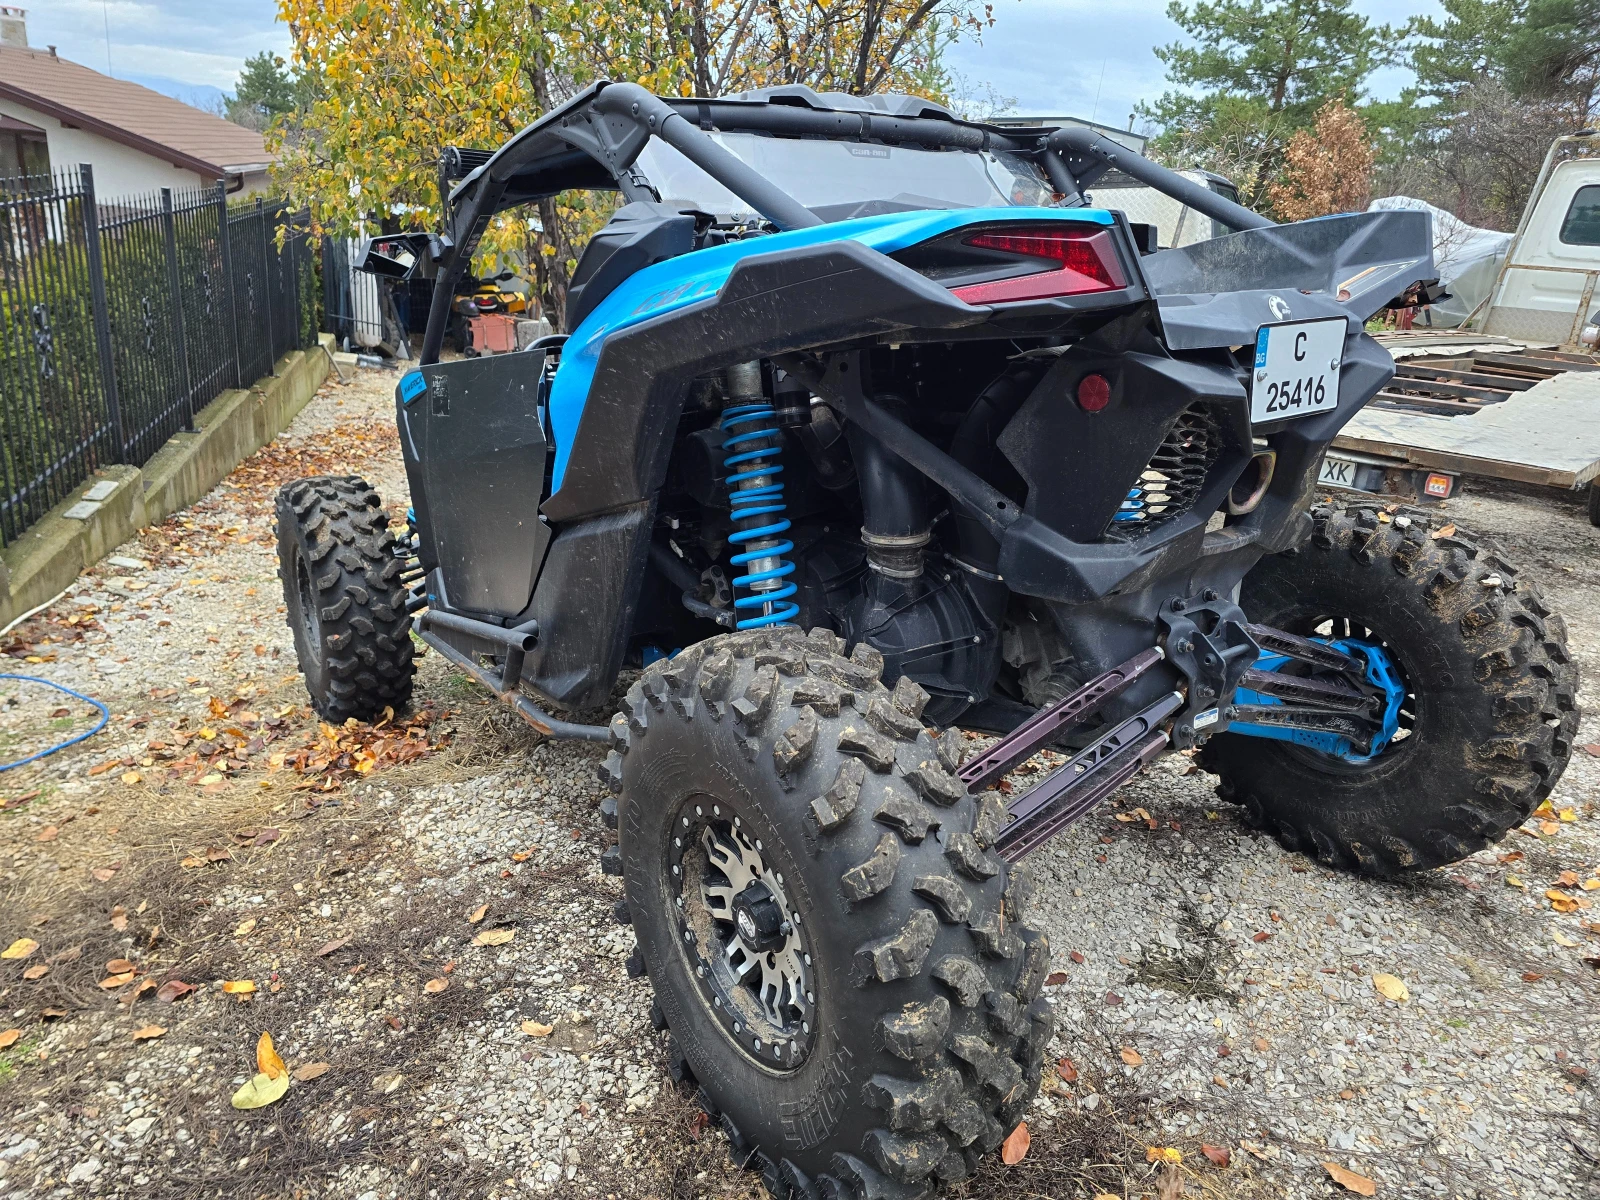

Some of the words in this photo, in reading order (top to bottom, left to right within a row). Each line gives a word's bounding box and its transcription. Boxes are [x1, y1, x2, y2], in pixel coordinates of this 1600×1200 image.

[1255, 352, 1266, 363] BG
[1294, 331, 1307, 362] C
[1265, 374, 1325, 413] 25416
[1323, 460, 1351, 483] XK
